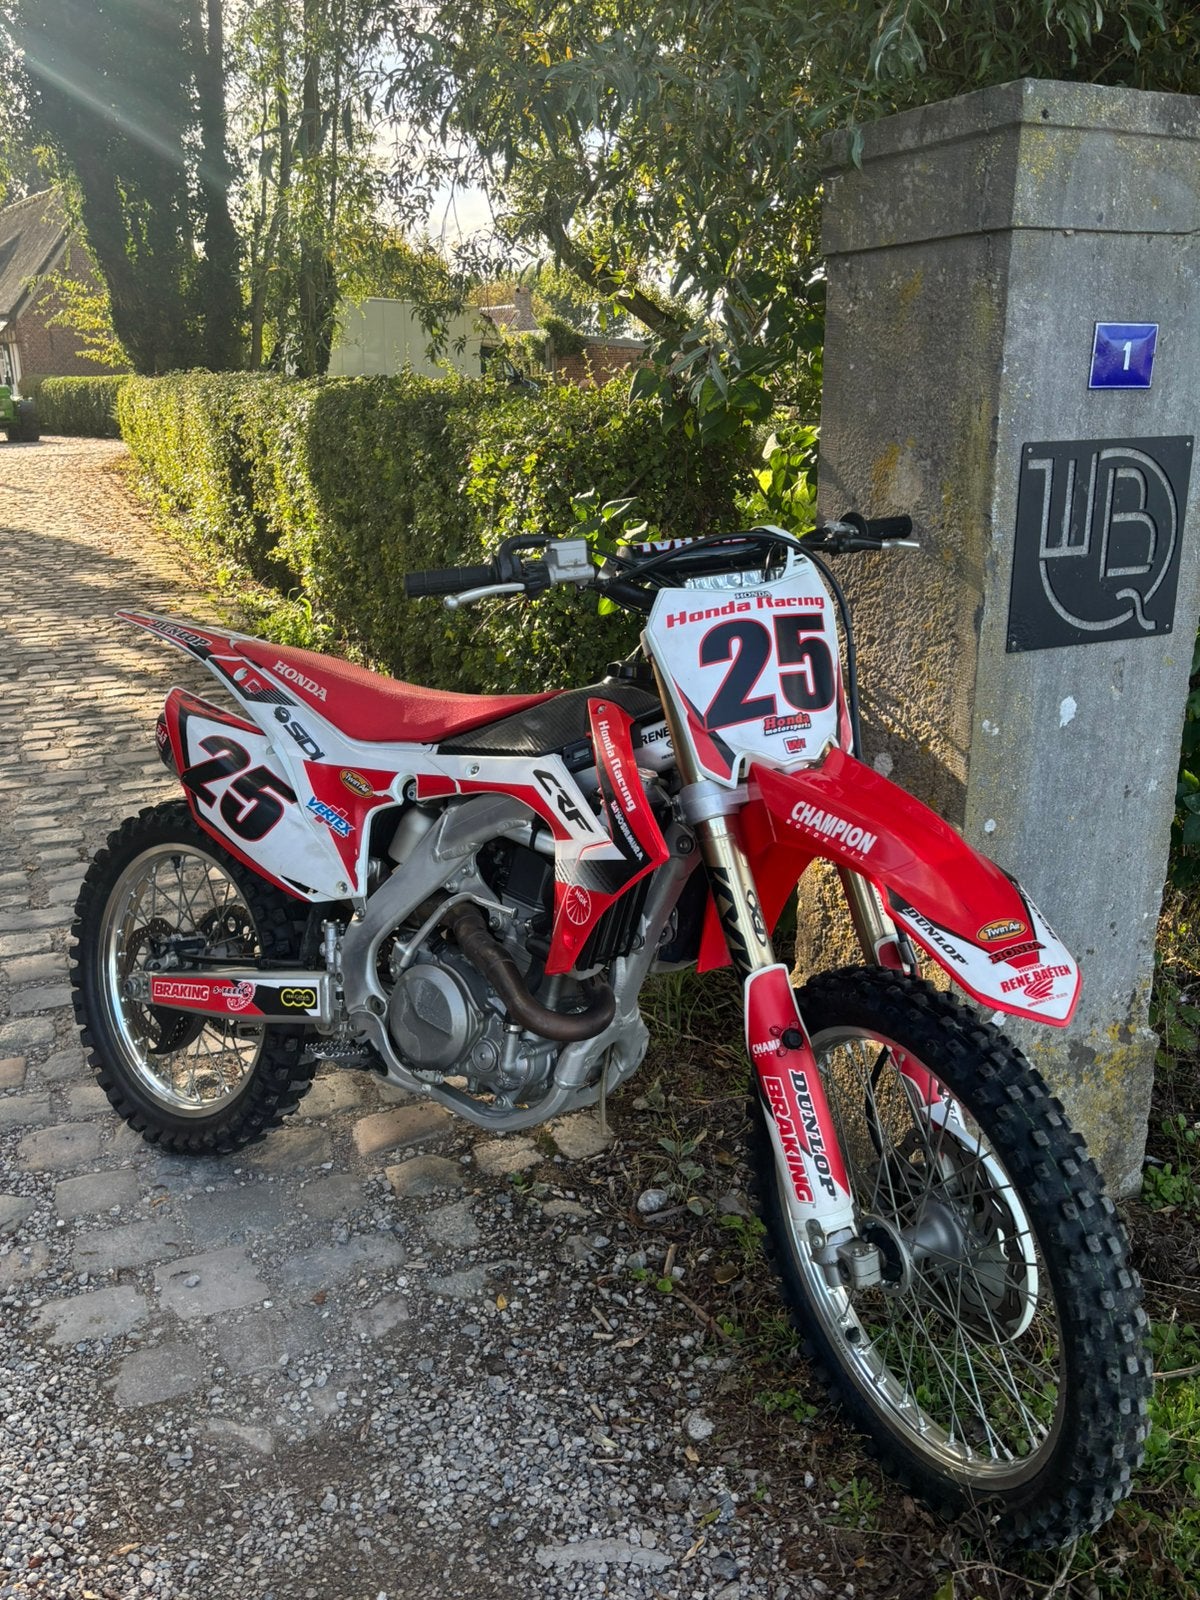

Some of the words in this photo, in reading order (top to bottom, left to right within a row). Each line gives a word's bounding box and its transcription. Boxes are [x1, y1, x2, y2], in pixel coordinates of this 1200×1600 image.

[1123, 341, 1132, 371] 1
[666, 601, 750, 629] Honda
[757, 597, 825, 610] Racing
[734, 590, 772, 600] HONDA
[150, 621, 211, 646] DUNLOP
[272, 660, 329, 702] HONDA
[699, 613, 836, 732] 25
[764, 712, 811, 731] Honda
[598, 720, 615, 758] Honda
[610, 757, 637, 813] Racing
[182, 735, 298, 842] 25
[533, 769, 594, 833] CRF
[306, 796, 354, 835] VERTEX
[791, 801, 878, 854] CHAMPION
[786, 818, 829, 842] MOTOR
[840, 846, 864, 860] OIL
[574, 889, 589, 907] NGK
[902, 906, 967, 966] DUNLOP
[985, 924, 1009, 939] Twin
[1009, 922, 1021, 933] Air
[988, 941, 1047, 964] HONDA
[154, 981, 209, 1001] BRAKING
[752, 1039, 781, 1054] CHAMP
[763, 1076, 815, 1203] BRAKING
[788, 1068, 836, 1197] DUNLOP
